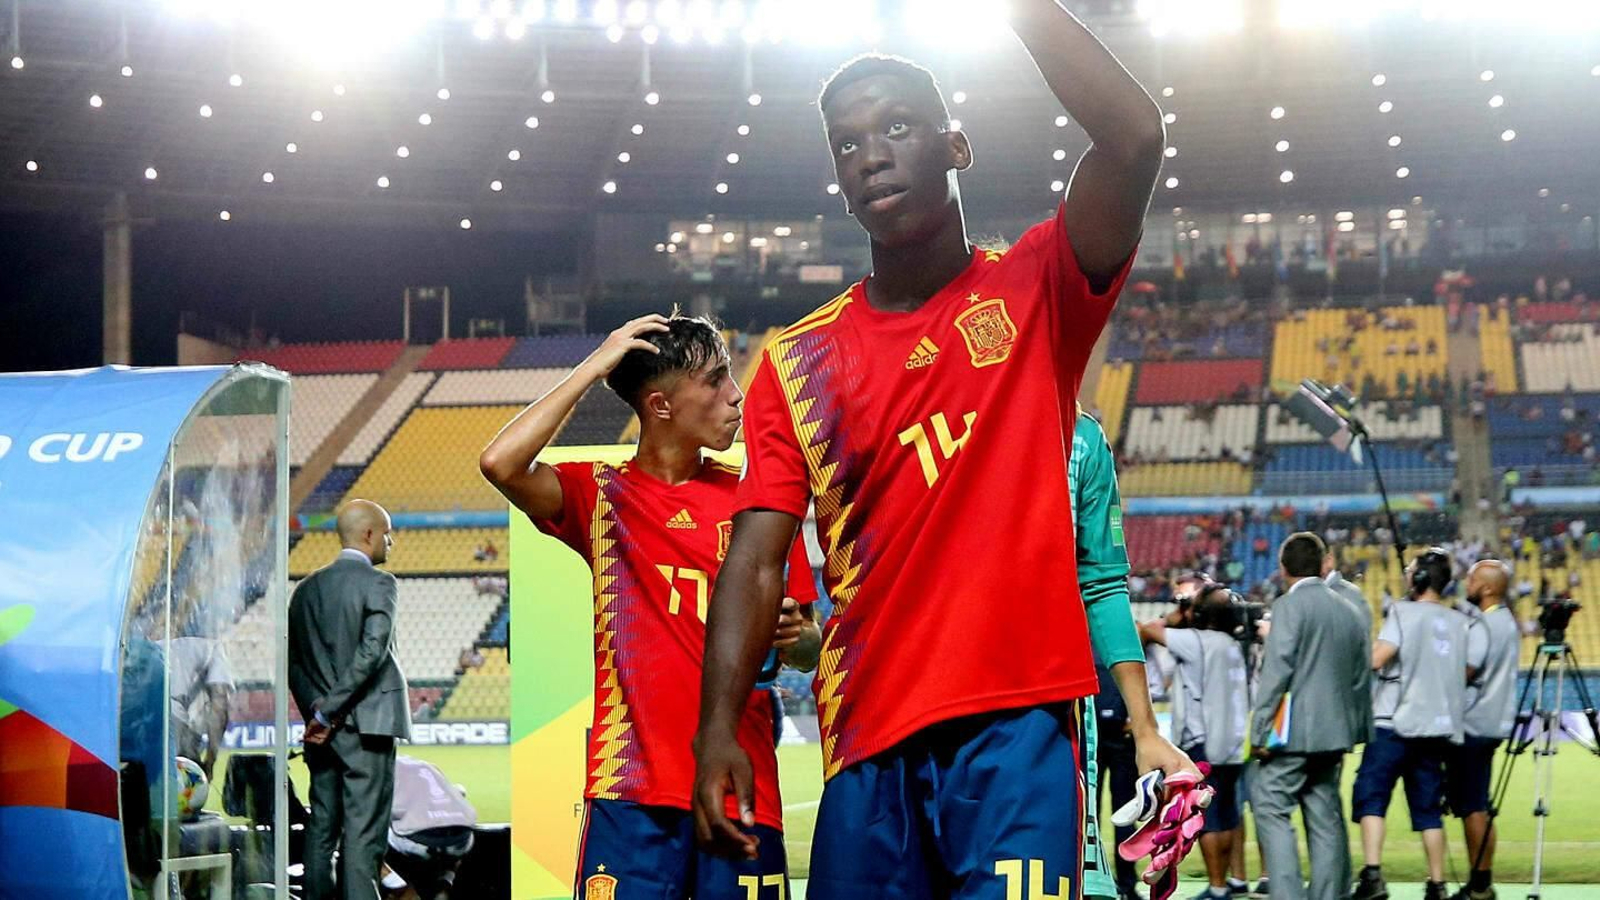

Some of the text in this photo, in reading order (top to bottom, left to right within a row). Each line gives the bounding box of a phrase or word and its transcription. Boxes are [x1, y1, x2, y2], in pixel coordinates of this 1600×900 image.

[28, 433, 143, 462] CUP
[898, 411, 977, 489] 14
[666, 521, 698, 529] adidas
[655, 564, 708, 624] 17
